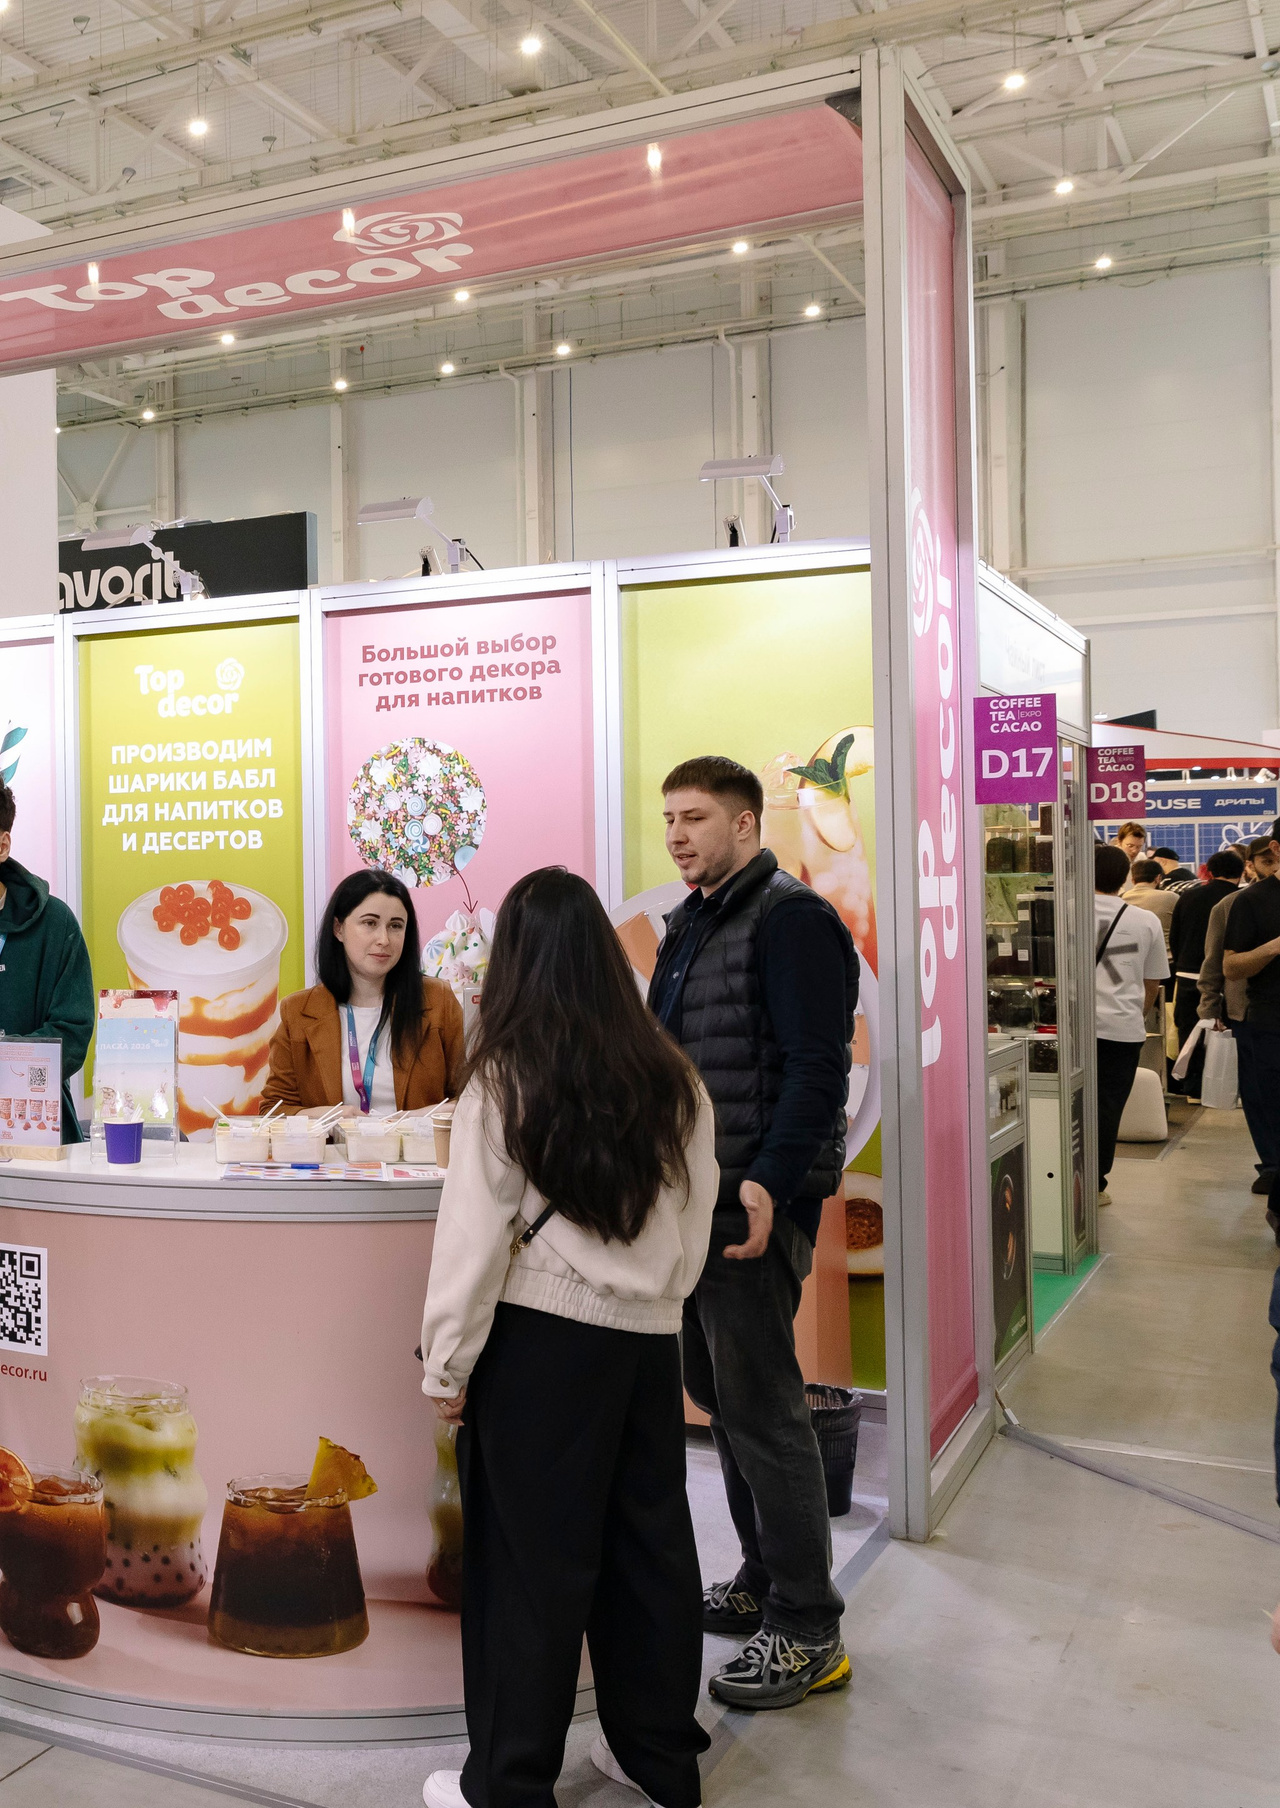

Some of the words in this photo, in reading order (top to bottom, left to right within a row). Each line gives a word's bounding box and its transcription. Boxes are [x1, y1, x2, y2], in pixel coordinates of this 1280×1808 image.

[157, 243, 473, 320] decor
[361, 637, 469, 663] Большой
[476, 632, 557, 657] выбор
[134, 664, 185, 695] Top
[358, 666, 463, 687] готового
[470, 658, 561, 682] декора
[157, 692, 240, 718] decor
[375, 693, 420, 712] для
[427, 685, 543, 706] напитков
[989, 697, 1042, 710] COFFEE
[989, 711, 1016, 721] TEA
[1020, 710, 1042, 718] EXPO
[989, 720, 1042, 733] CACAO
[111, 737, 272, 765] ПРОИЗВОДИМ
[935, 535, 959, 960] decor
[1097, 747, 1134, 756] COFFEE
[1097, 756, 1116, 764] TEA
[981, 747, 1053, 779] D17
[1098, 763, 1135, 772] CACAO
[108, 771, 207, 794] ШАРИКИ
[212, 768, 276, 790] БАБЛ
[1090, 781, 1144, 804] D18
[102, 802, 149, 826] ДЛЯ
[154, 799, 284, 822] НАПИТКОВ
[1214, 797, 1265, 807] ДРИПЫ
[122, 832, 137, 852] И
[142, 829, 263, 855] ДЕСЕРТОВ
[100, 1042, 129, 1050] ПАСХА
[131, 1042, 151, 1050] 2026
